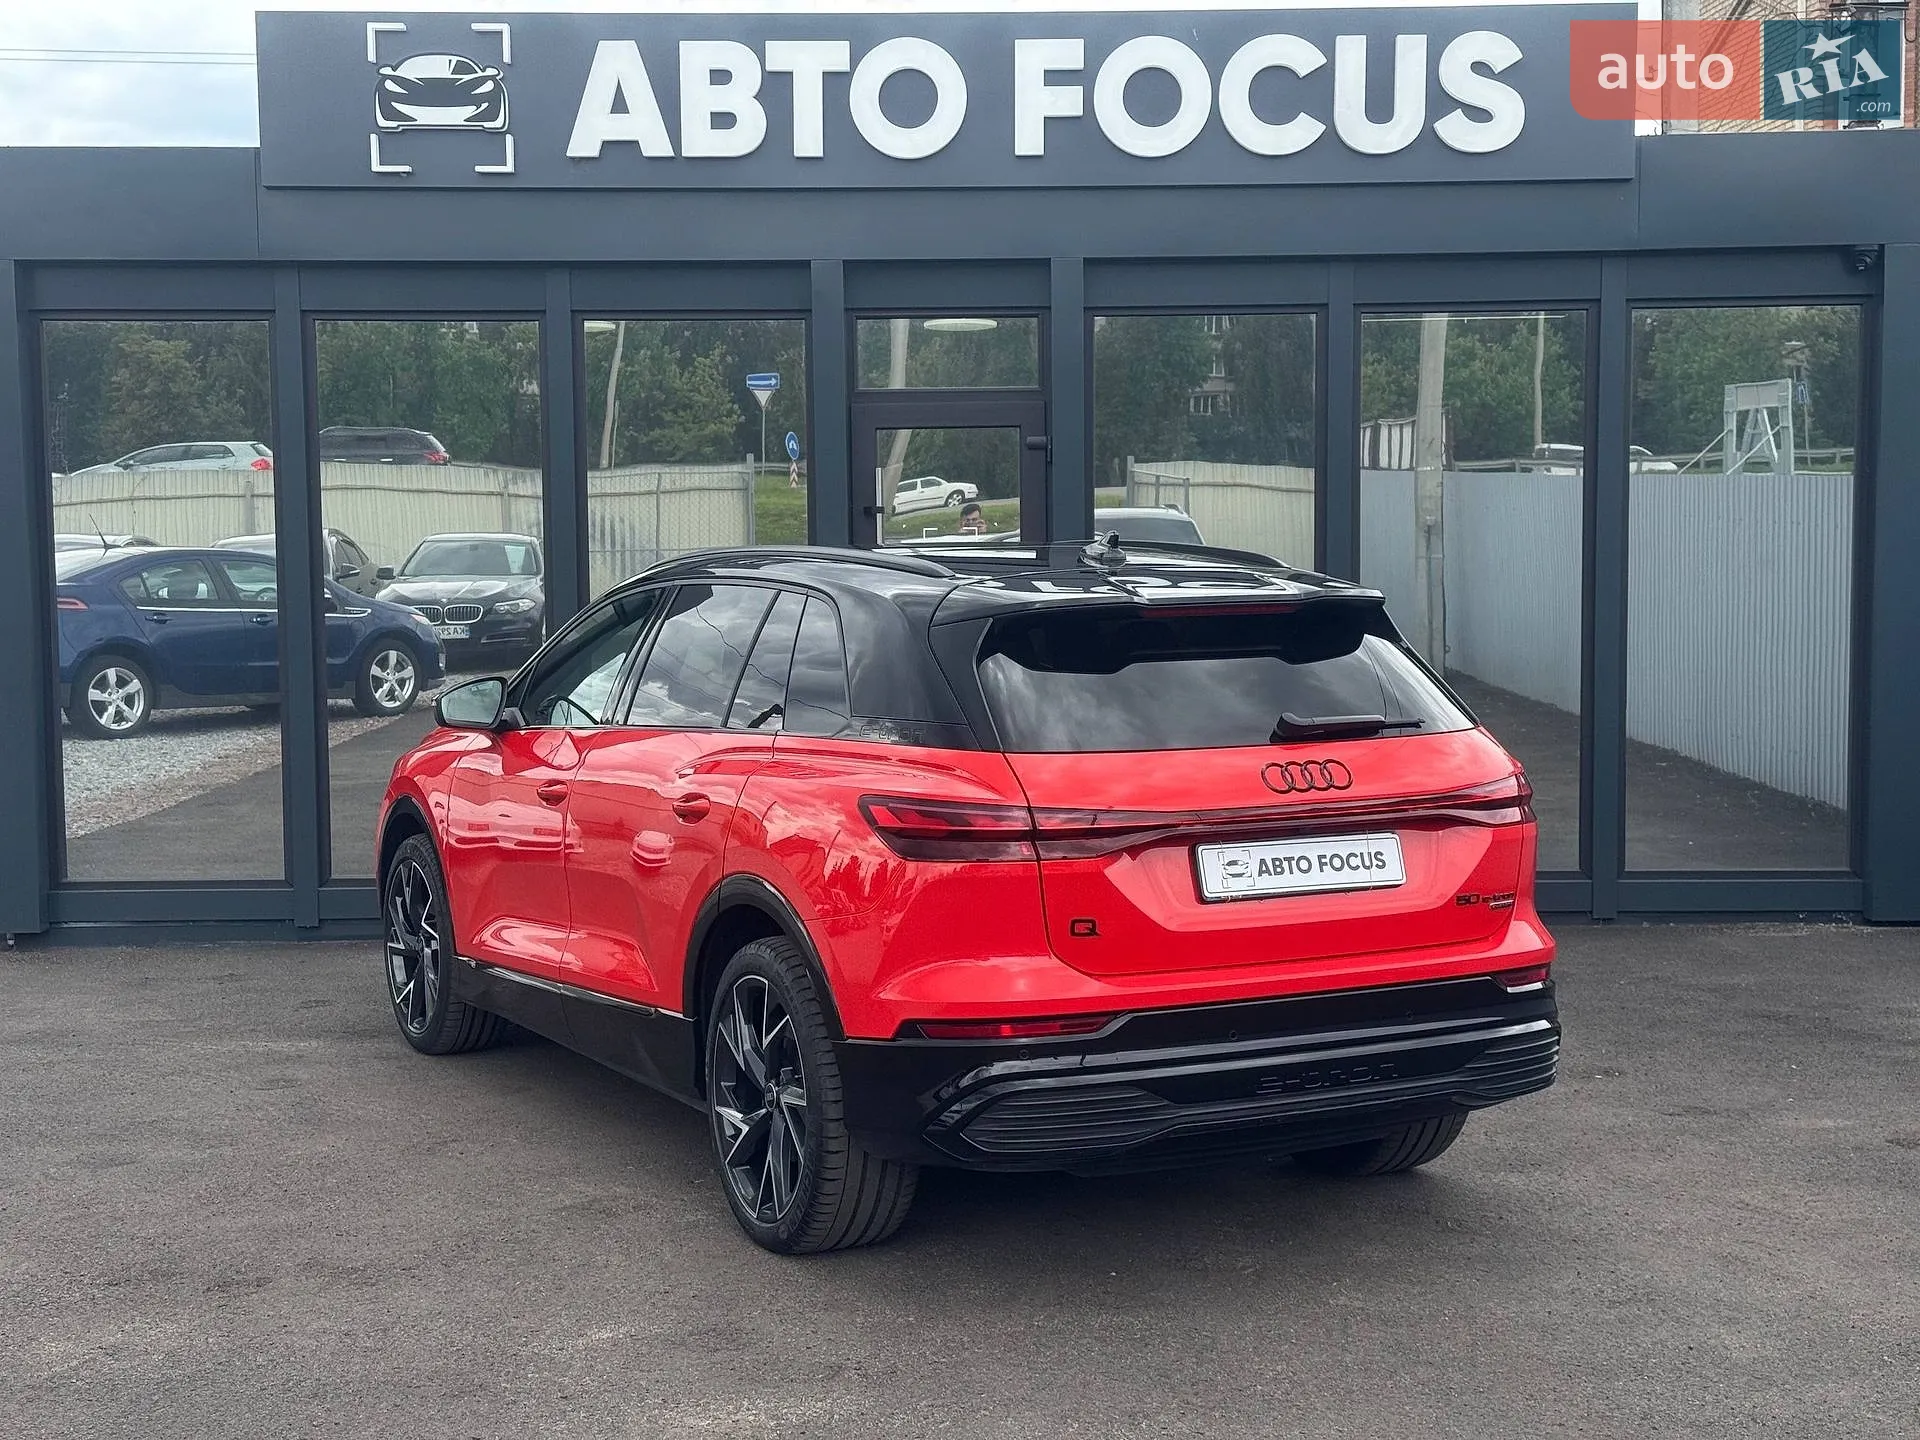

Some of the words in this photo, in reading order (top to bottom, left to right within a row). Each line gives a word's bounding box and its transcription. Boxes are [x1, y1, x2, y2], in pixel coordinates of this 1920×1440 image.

[566, 36, 968, 160] АВТО
[1014, 31, 1525, 157] FOCUS
[1257, 855, 1312, 878] АВТО
[1317, 851, 1387, 873] FOCUS
[1456, 893, 1480, 906] 50
[1069, 918, 1102, 937] Q
